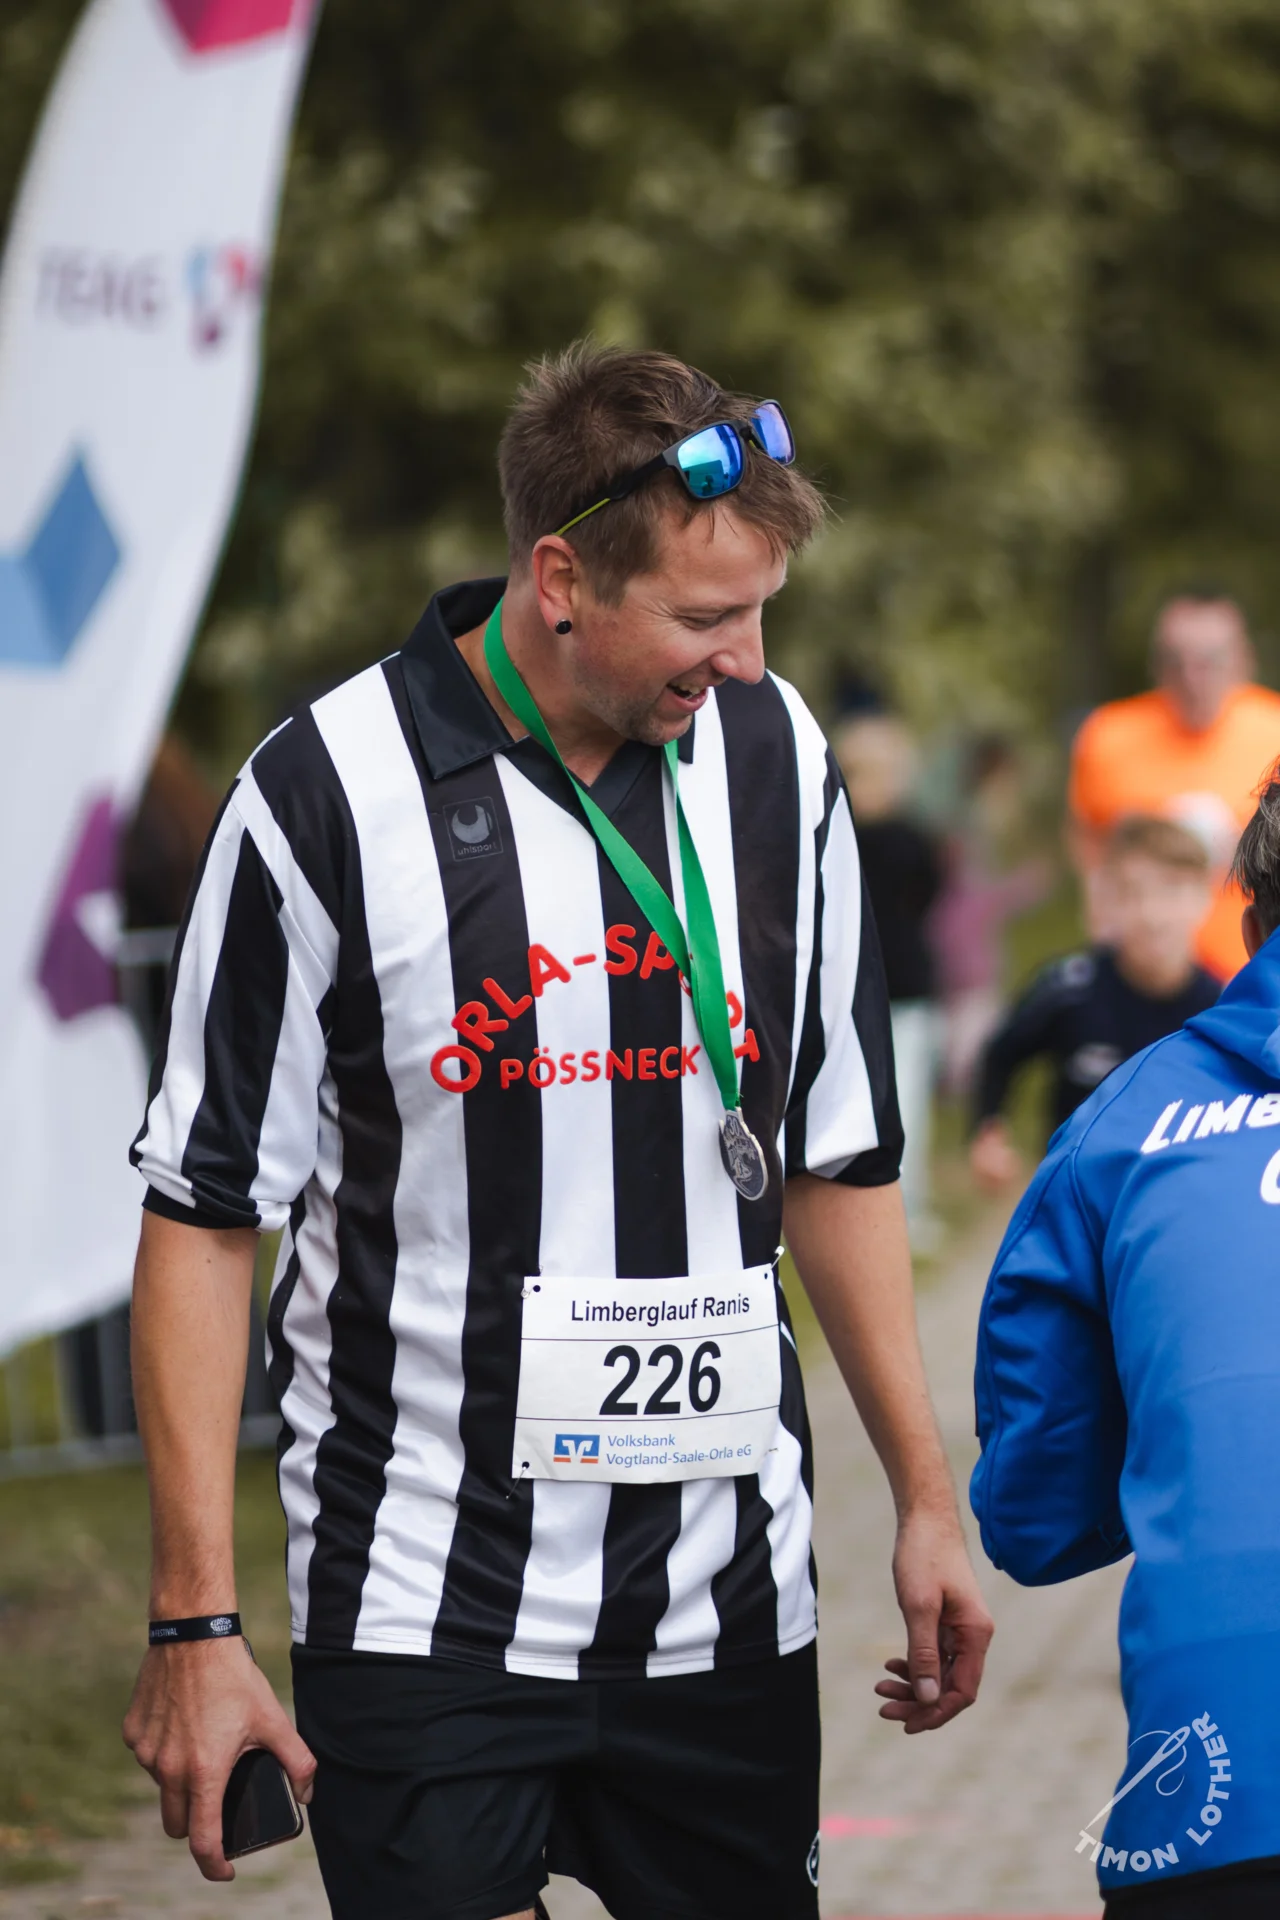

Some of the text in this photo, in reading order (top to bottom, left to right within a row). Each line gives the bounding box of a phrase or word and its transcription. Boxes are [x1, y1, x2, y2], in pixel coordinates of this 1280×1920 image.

[458, 842, 496, 856] uhlsport
[430, 924, 760, 1093] ORLA-SPT
[500, 1046, 701, 1089] PÖSSNECK
[571, 1294, 750, 1327] Limberglauf Ranis
[600, 1341, 722, 1415] 226
[606, 1444, 752, 1468] Vogtland-Saale-Orla eG
[607, 1434, 676, 1448] Volksbank
